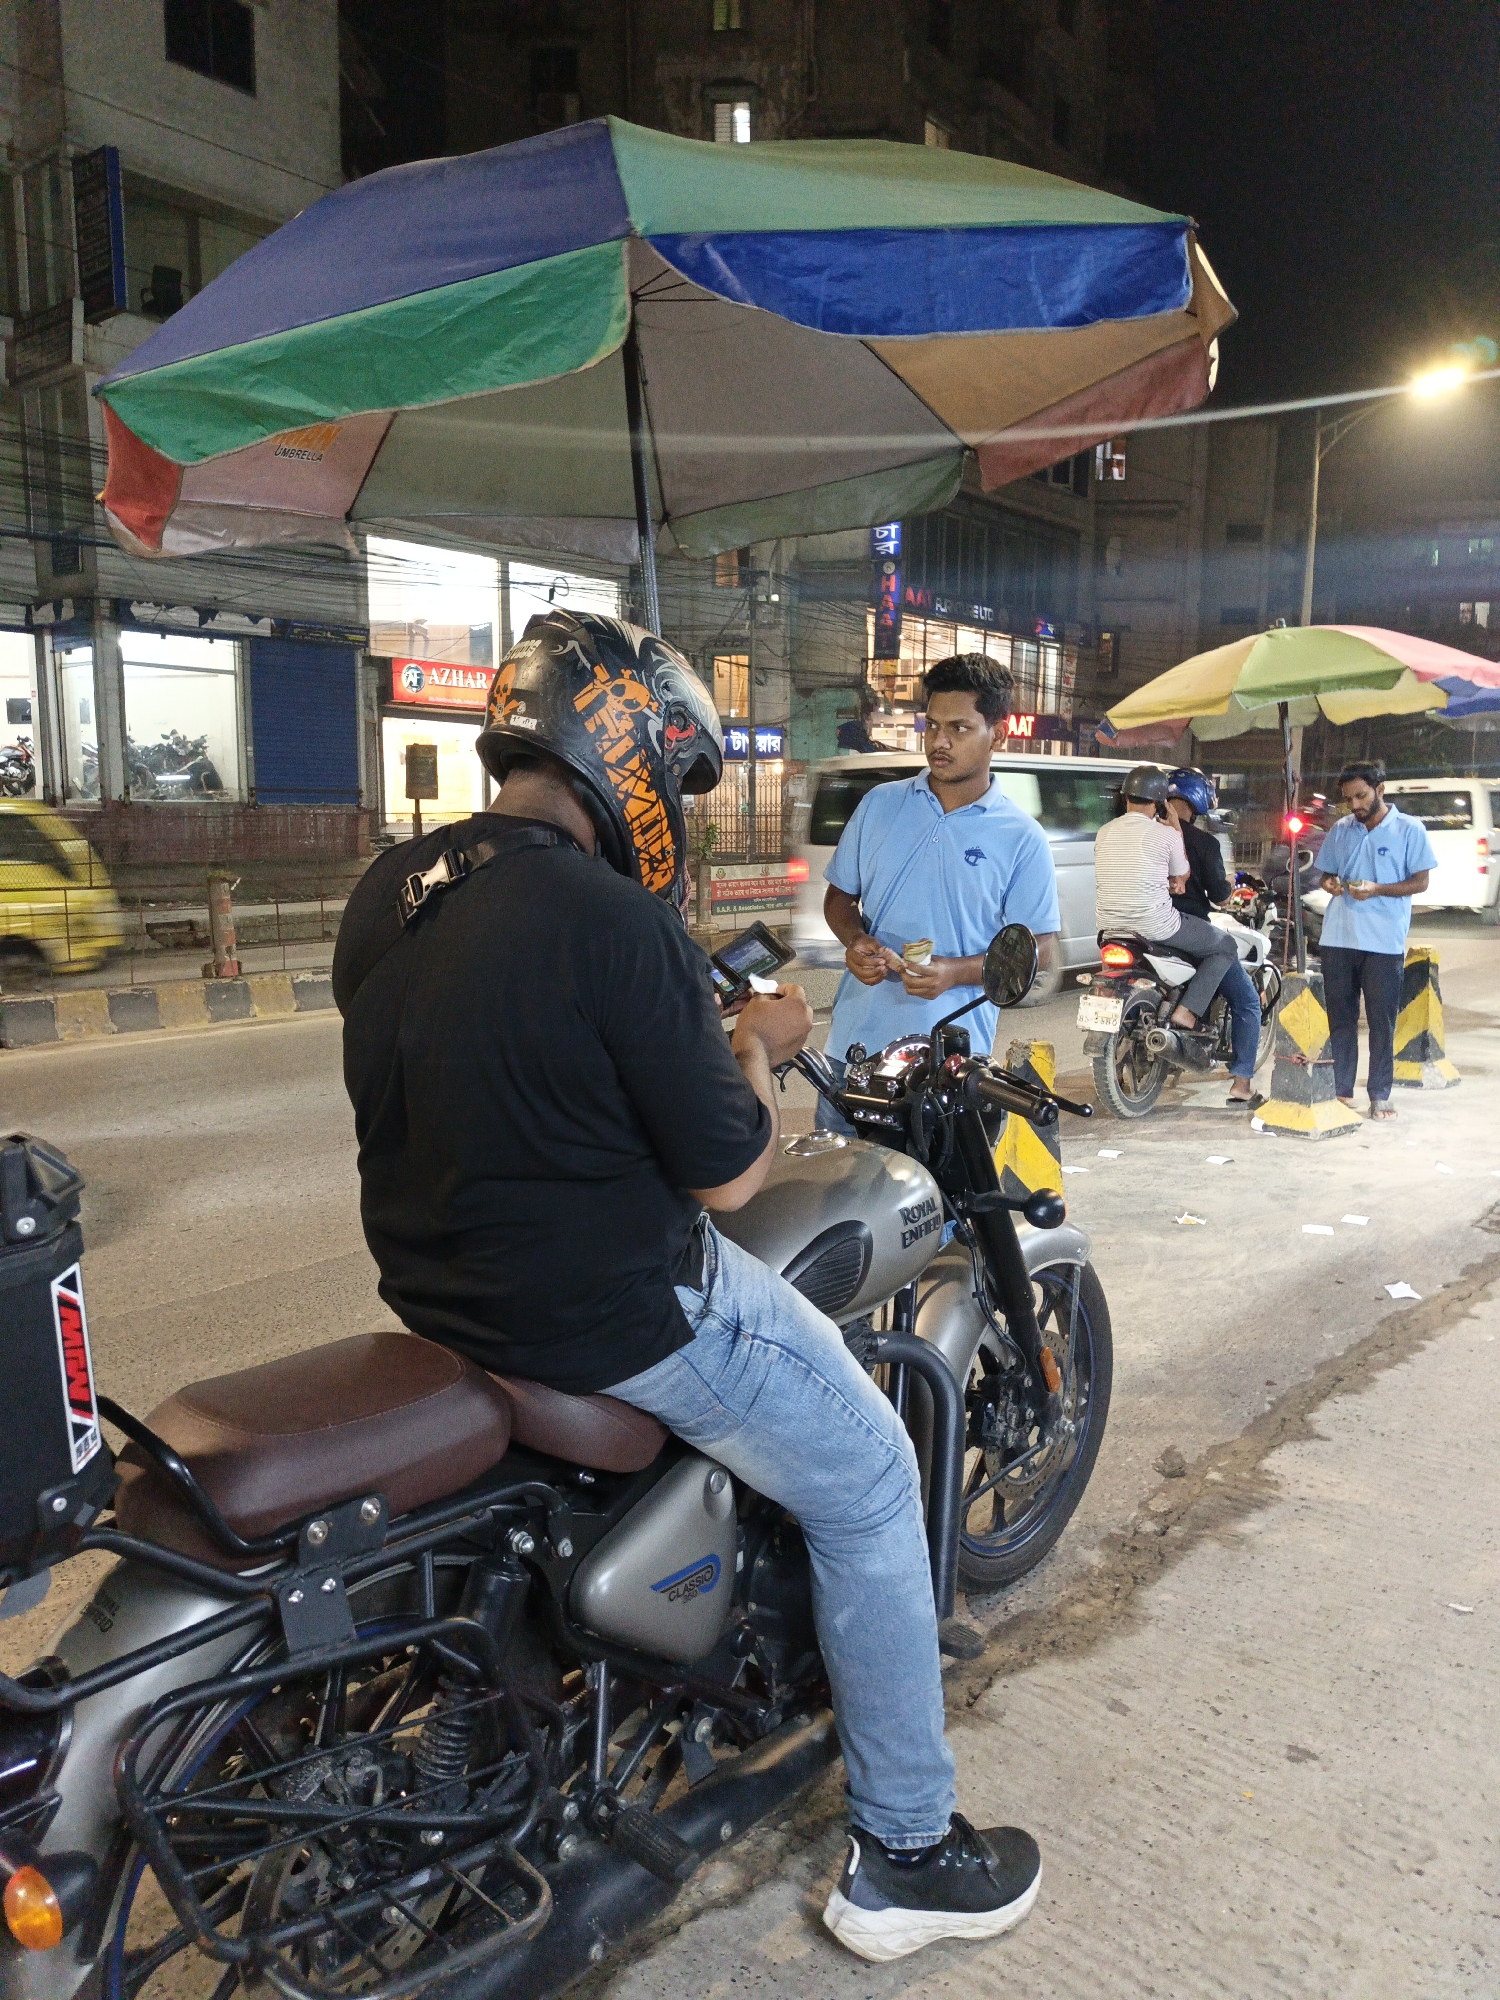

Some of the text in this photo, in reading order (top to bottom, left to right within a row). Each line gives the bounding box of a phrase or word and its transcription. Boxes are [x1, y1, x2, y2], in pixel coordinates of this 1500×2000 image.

[274, 443, 324, 462] UMBRELLA
[905, 586, 934, 609] AAT
[428, 667, 489, 690] AZHAR
[1008, 714, 1035, 737] AAT
[730, 729, 782, 754] টায়ার
[898, 1196, 938, 1227] ROYAL
[668, 1569, 712, 1602] CLASSIC
